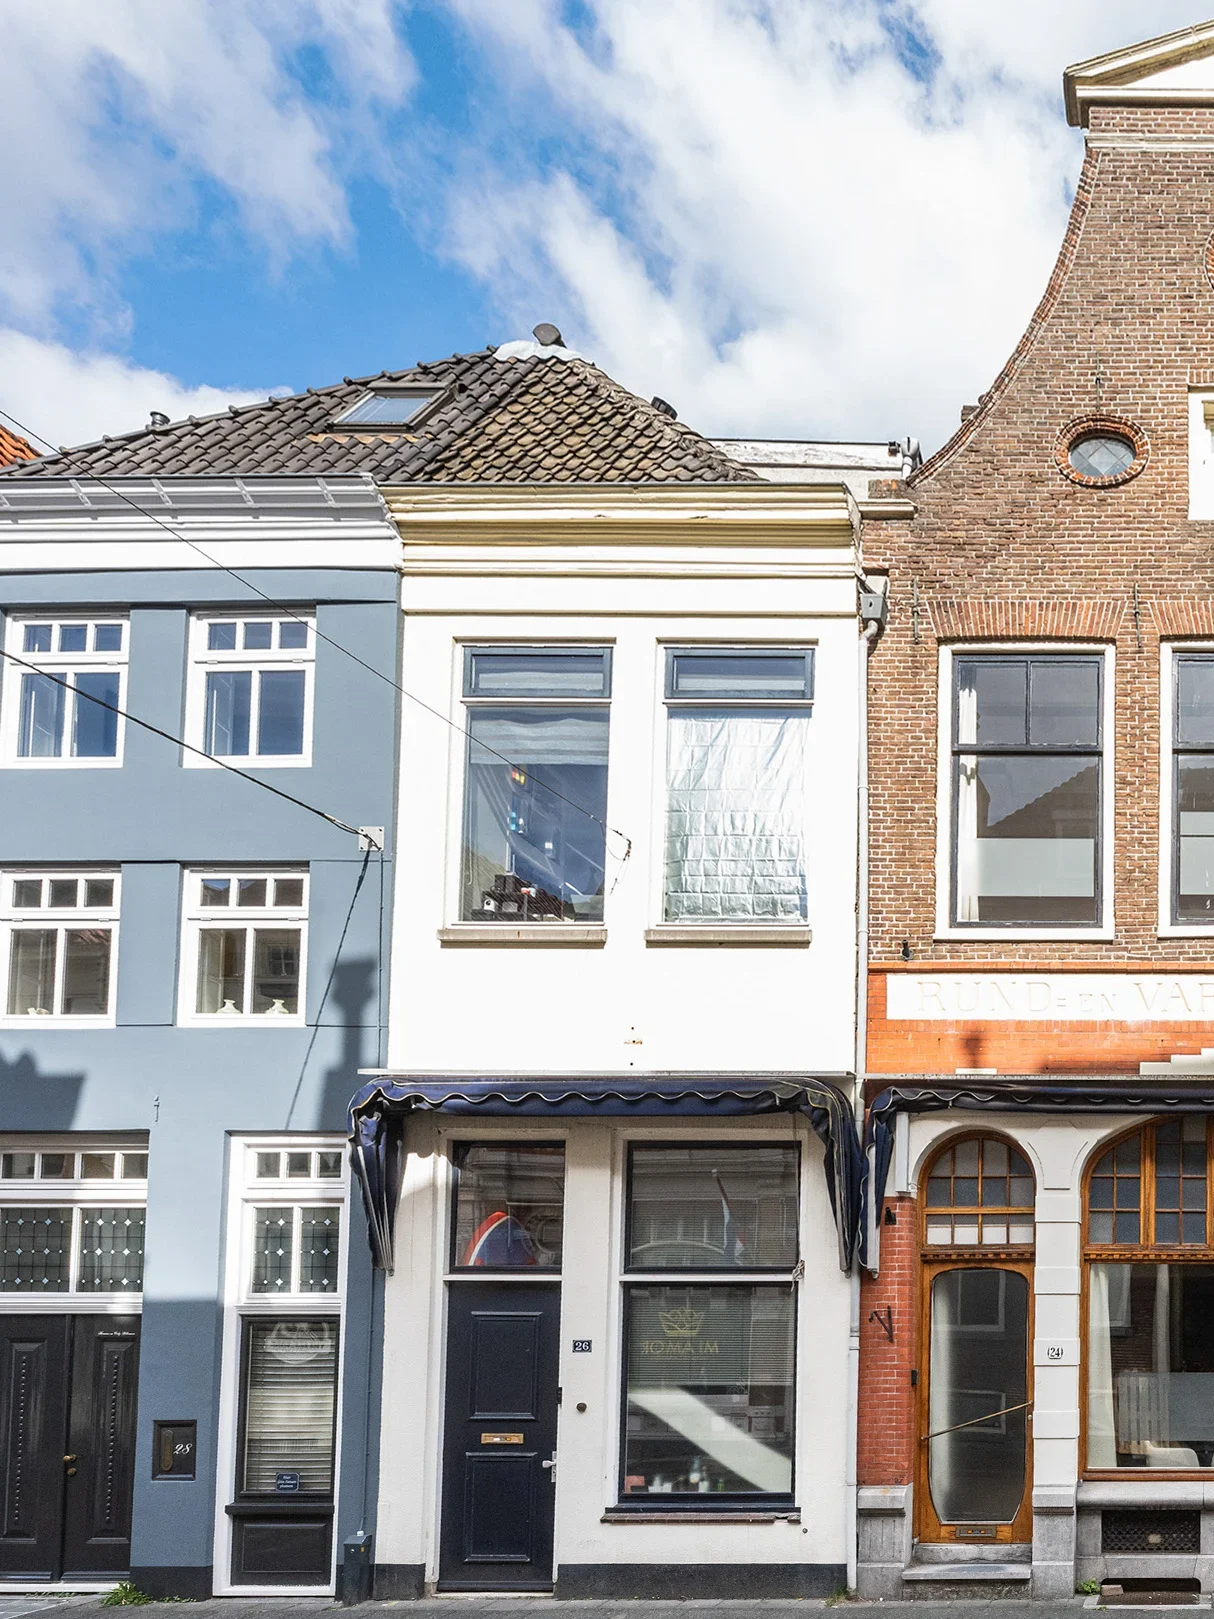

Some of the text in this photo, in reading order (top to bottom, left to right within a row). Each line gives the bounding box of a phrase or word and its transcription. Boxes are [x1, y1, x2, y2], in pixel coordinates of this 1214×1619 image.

[1078, 993, 1117, 1013] EN
[575, 1341, 590, 1351] 26
[173, 1443, 193, 1455] 28
